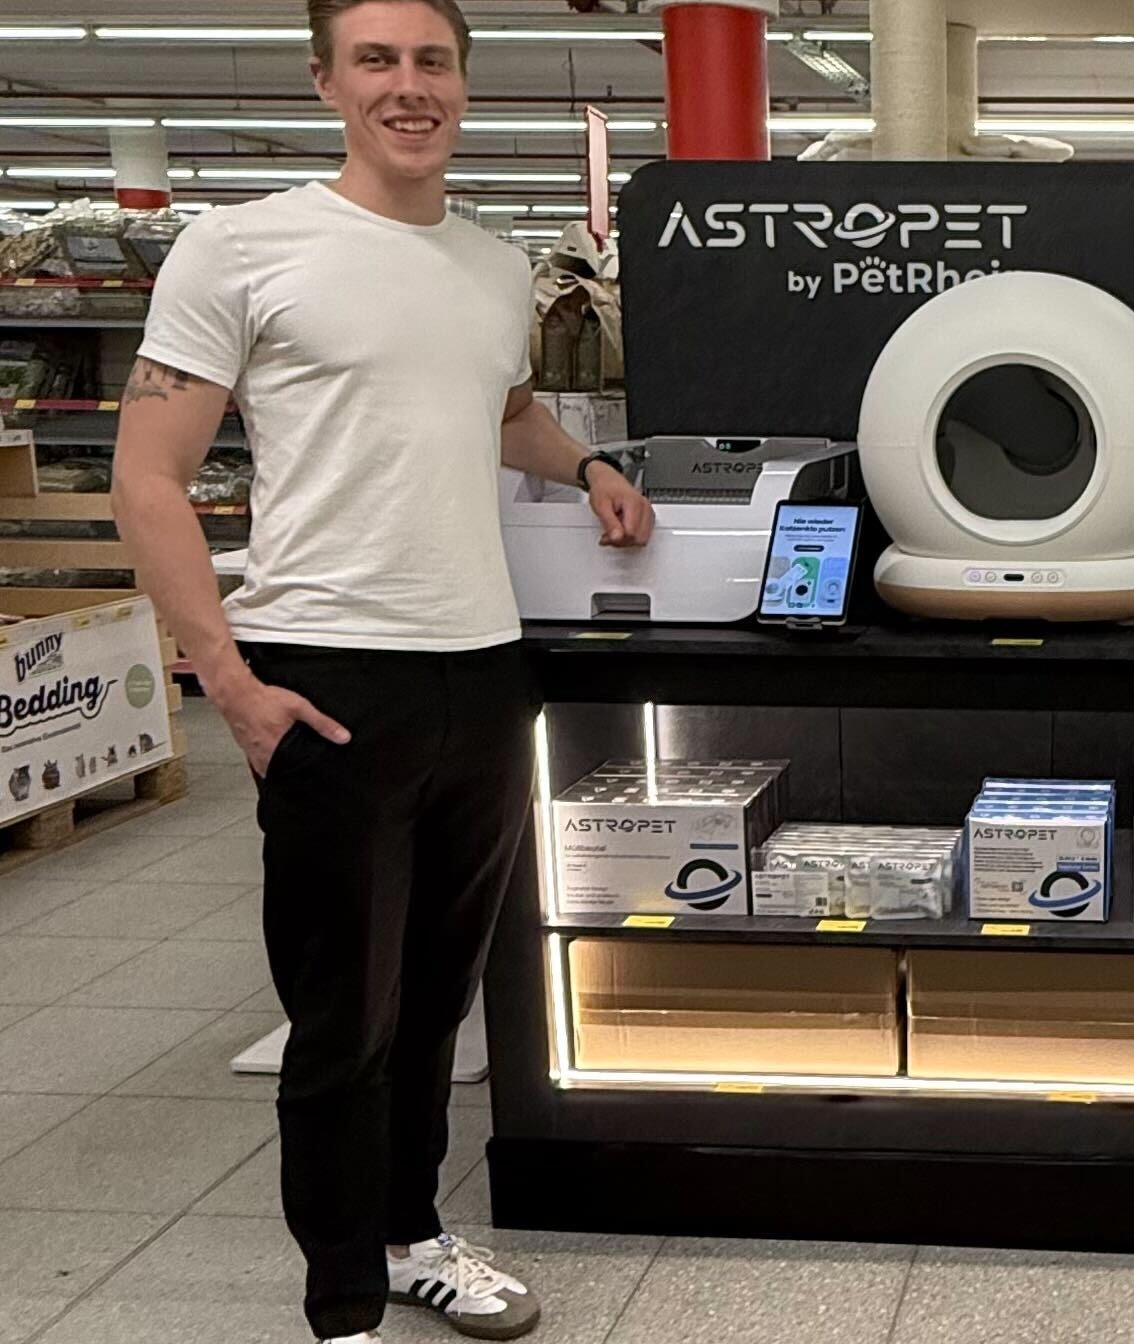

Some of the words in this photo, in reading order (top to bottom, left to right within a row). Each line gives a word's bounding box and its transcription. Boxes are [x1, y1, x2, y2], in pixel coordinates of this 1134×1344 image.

[658, 201, 1028, 249] ASTROPET
[787, 271, 821, 299] by
[833, 258, 1013, 294] PetRh
[692, 461, 763, 474] ASTROP
[14, 631, 66, 683] bunny
[0, 675, 104, 729] Bedding
[564, 817, 677, 834] ASTROPET
[973, 828, 1058, 841] ASTROPET
